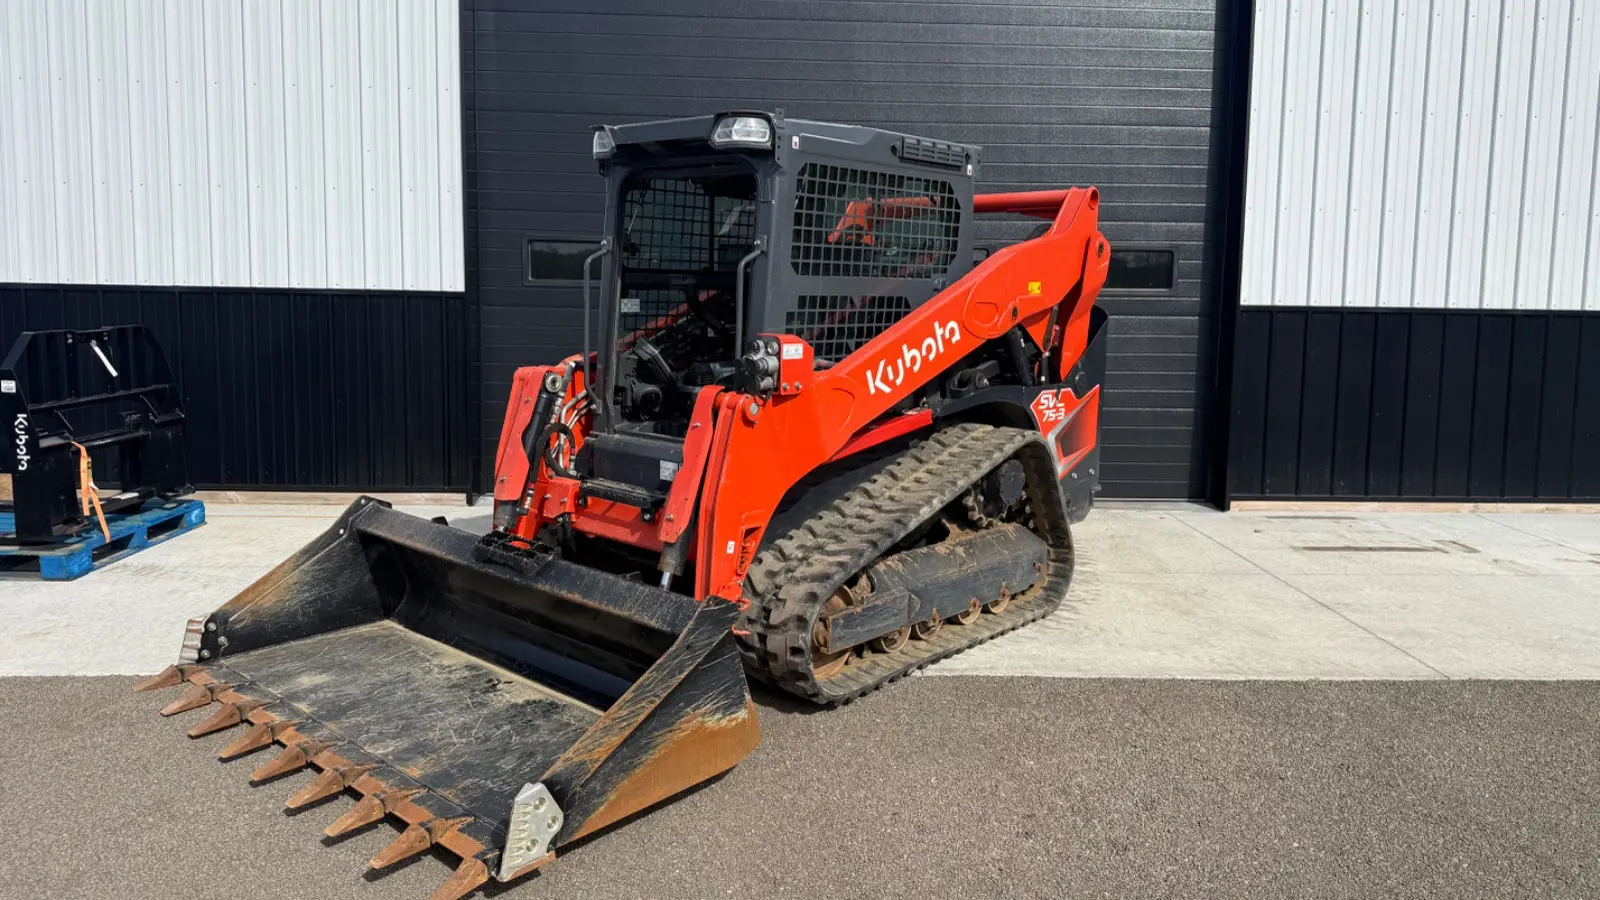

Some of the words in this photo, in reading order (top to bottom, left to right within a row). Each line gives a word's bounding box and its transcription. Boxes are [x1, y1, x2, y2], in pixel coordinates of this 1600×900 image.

[866, 320, 960, 395] Kubota
[14, 413, 31, 471] Kubota
[1042, 407, 1066, 422] 75-3
